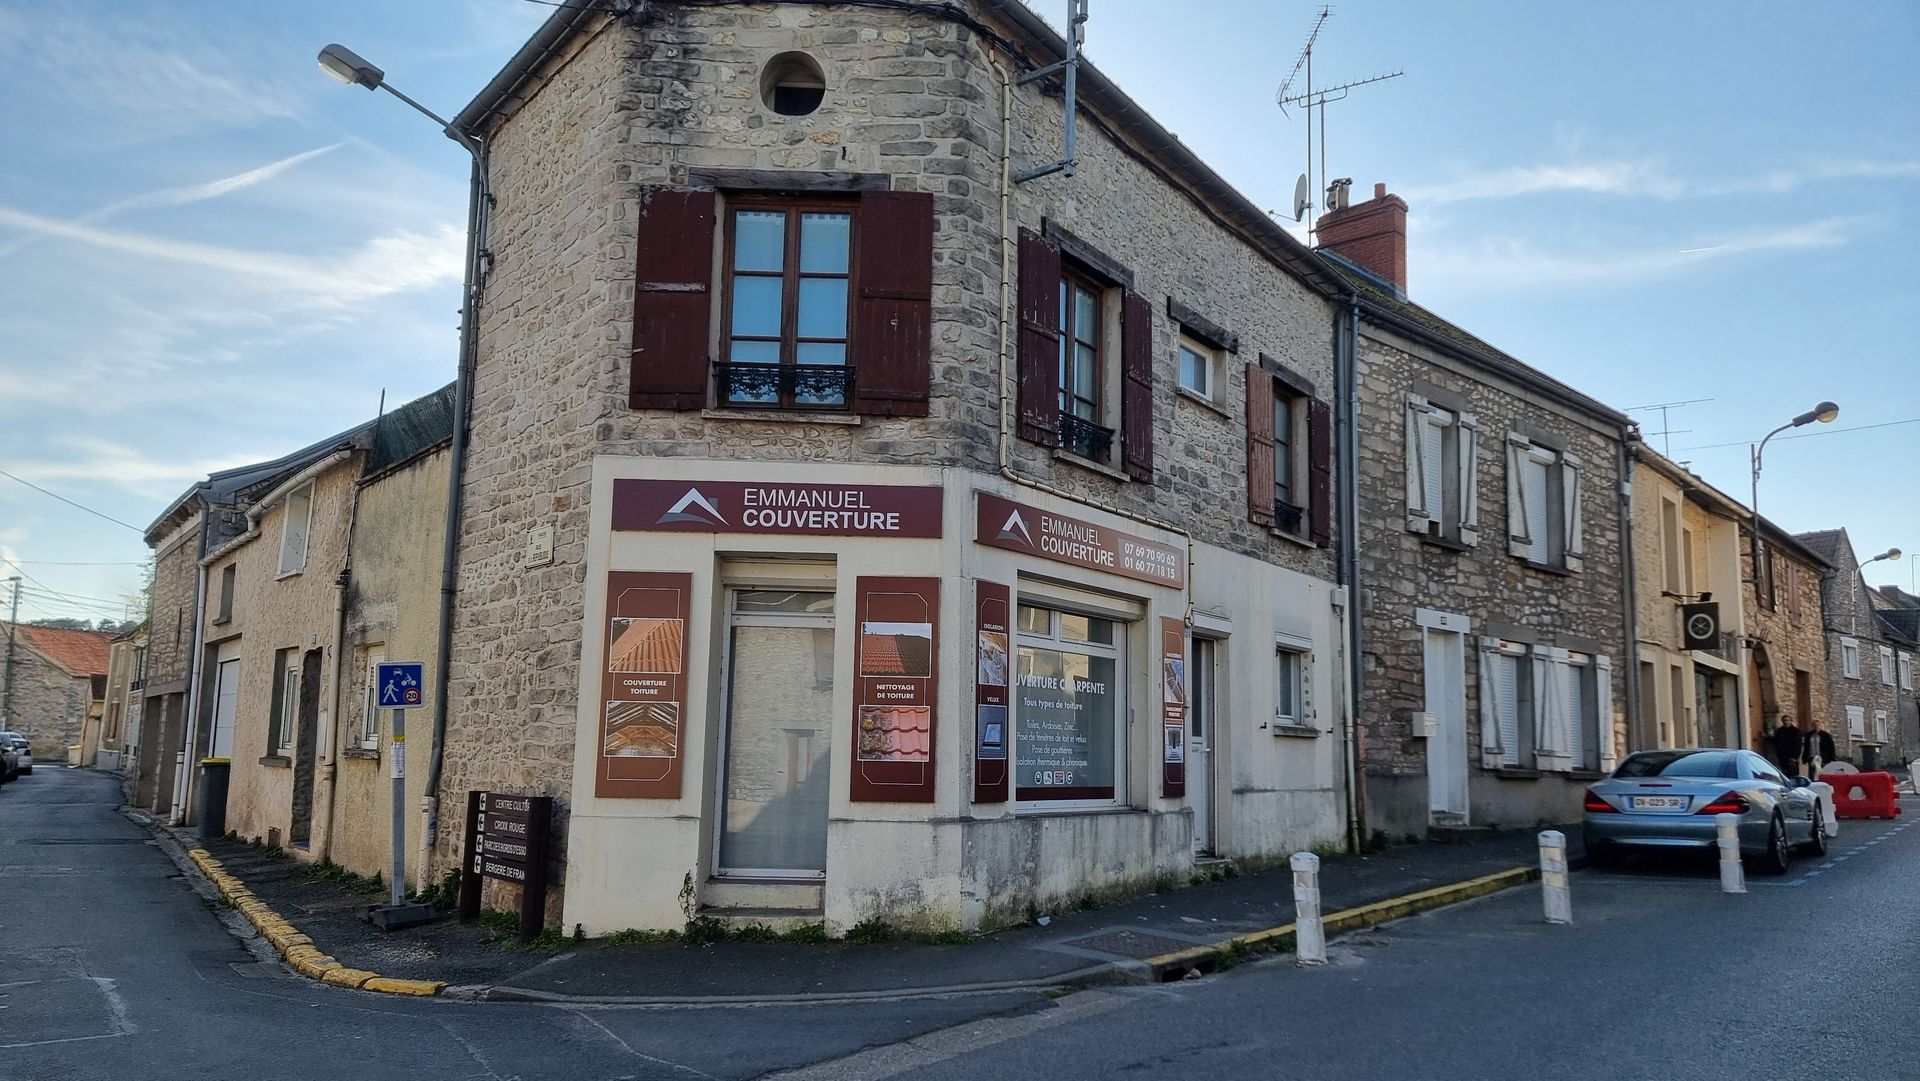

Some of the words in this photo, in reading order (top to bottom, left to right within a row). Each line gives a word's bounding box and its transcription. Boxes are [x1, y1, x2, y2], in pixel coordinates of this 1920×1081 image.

[744, 488, 871, 509] EMMANUEL
[743, 509, 900, 530] COUVERTURE
[1041, 516, 1101, 546] EMMANUEL
[1041, 535, 1114, 567] COUVERTURE
[1124, 543, 1134, 554] 07
[1135, 546, 1145, 557] 69
[1146, 549, 1155, 560] 70
[1156, 551, 1165, 563] 90
[1166, 554, 1175, 566] 62
[1124, 557, 1133, 569] 01
[1135, 559, 1145, 571] 60
[1146, 562, 1155, 574] 77
[1157, 565, 1165, 577] 18
[1167, 567, 1175, 579] 15
[983, 623, 1004, 631] ISOLATION
[623, 679, 667, 687] COUVERTURE
[1016, 674, 1058, 690] UVERTURE
[1024, 697, 1037, 707] Tous
[1038, 699, 1055, 710] types
[1056, 700, 1063, 709] de
[1064, 701, 1083, 711] toiture
[1016, 757, 1036, 767] solation
[495, 799, 513, 810] CENTRE
[494, 820, 508, 831] CROIX
[508, 822, 526, 834] ROUGE
[484, 840, 493, 851] PARC
[500, 843, 513, 854] BORDS
[506, 866, 513, 878] DE
